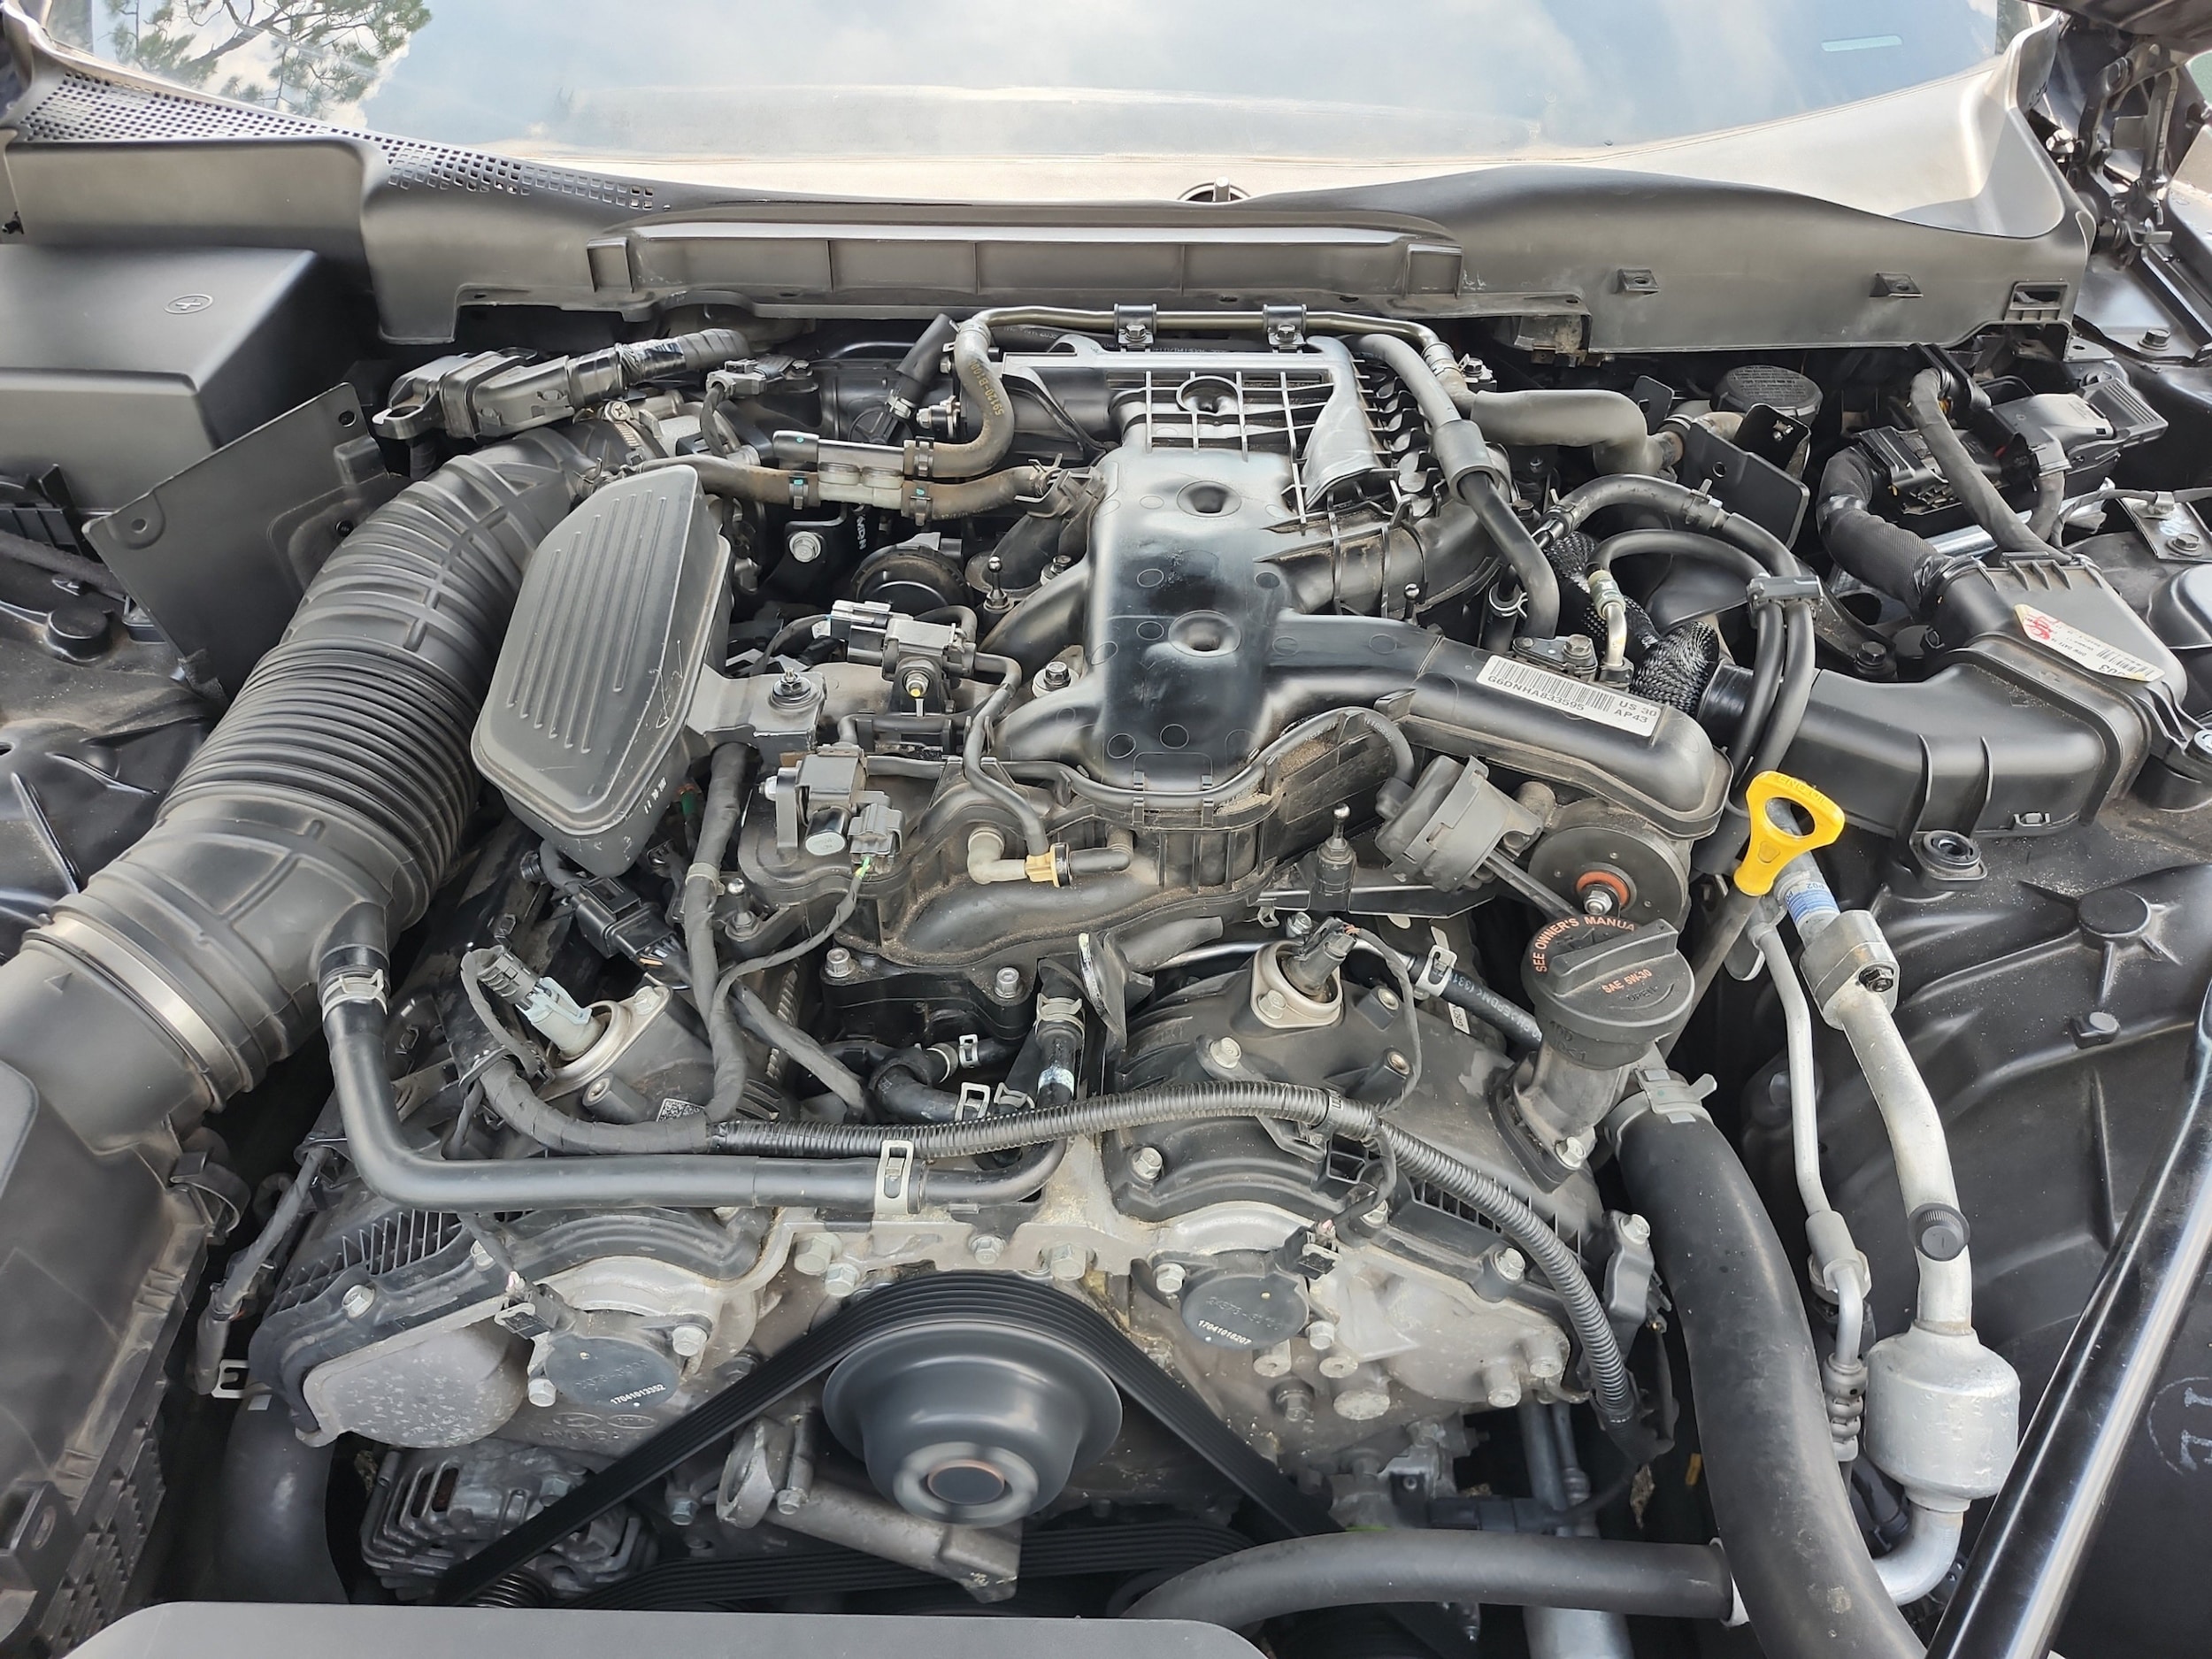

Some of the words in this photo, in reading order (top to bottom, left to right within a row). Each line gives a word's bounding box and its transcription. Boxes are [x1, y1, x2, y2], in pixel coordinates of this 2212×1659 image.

[1487, 675, 1586, 712] G6DNHA833595
[1613, 708, 1649, 724] AP43
[1618, 700, 1637, 711] US
[1640, 706, 1658, 718] 30
[1584, 916, 1635, 932] MANUA
[1535, 918, 1580, 951] OWNER'S
[1532, 952, 1548, 972] SEE
[1601, 979, 1624, 995] SAE
[1624, 969, 1653, 987] 5W-30
